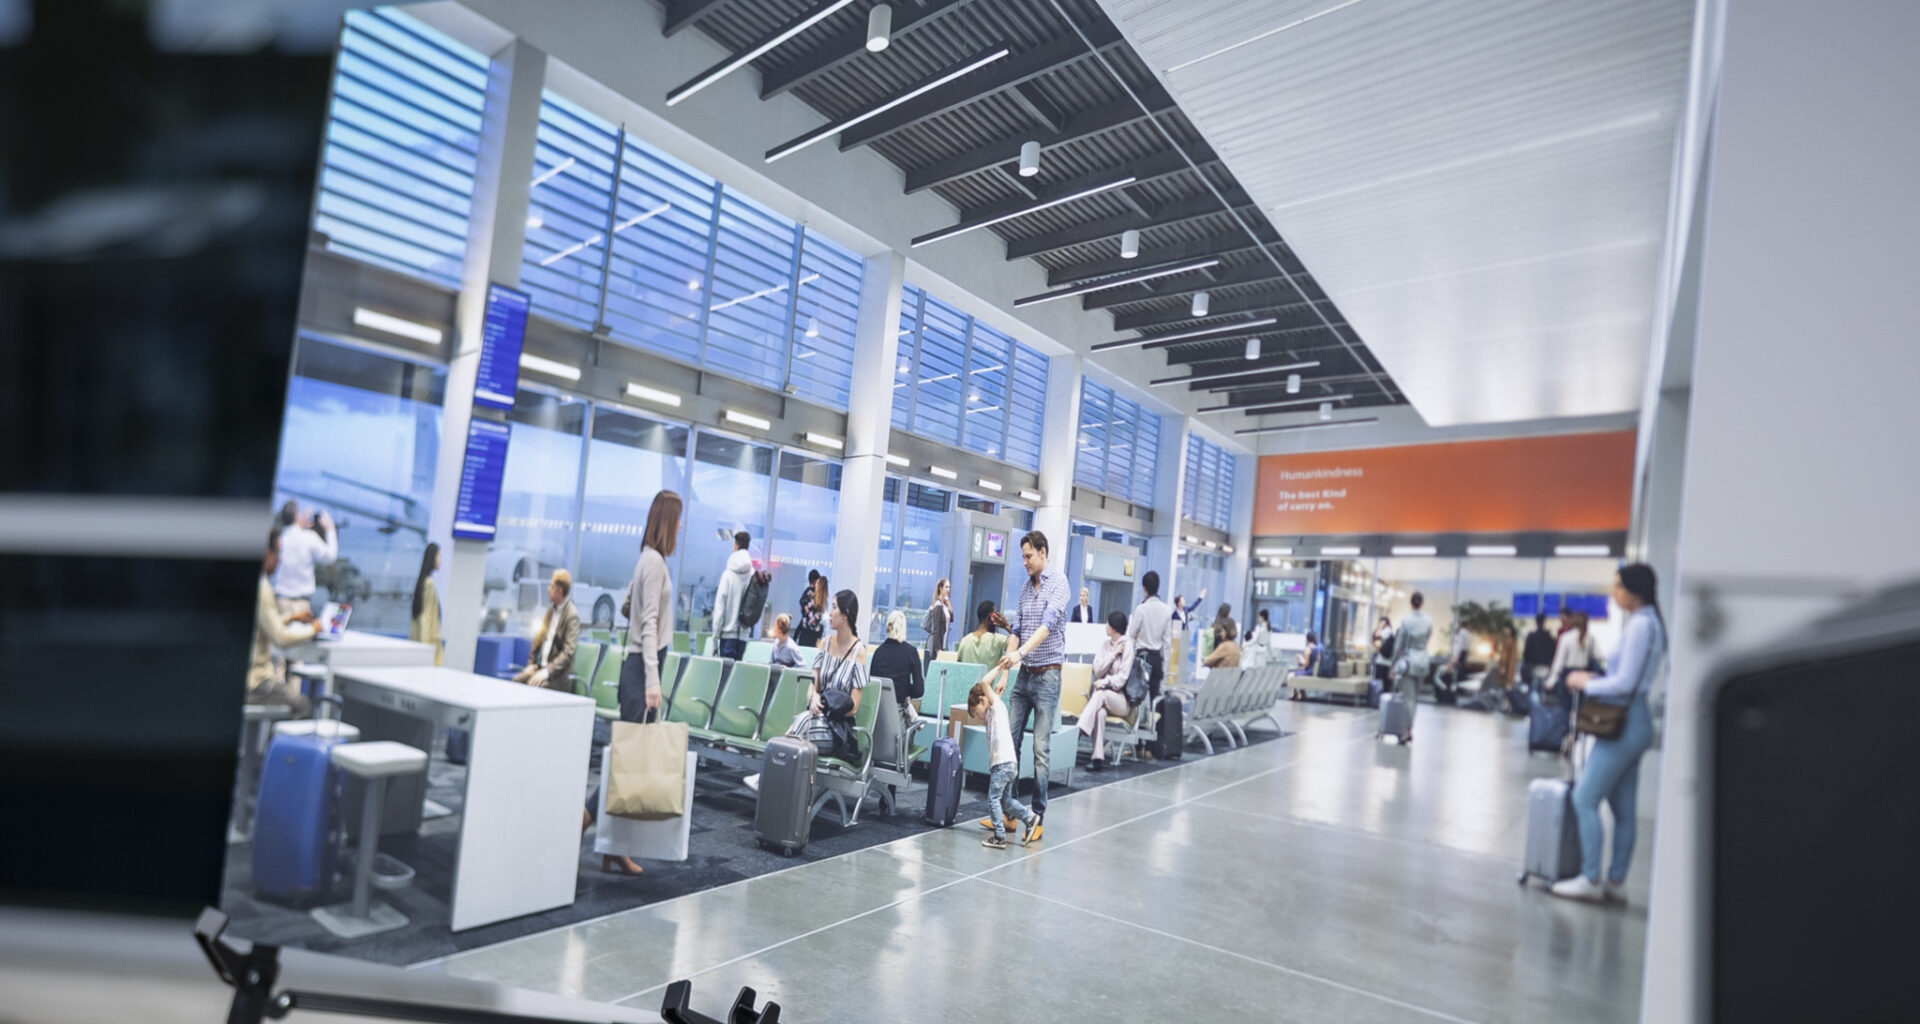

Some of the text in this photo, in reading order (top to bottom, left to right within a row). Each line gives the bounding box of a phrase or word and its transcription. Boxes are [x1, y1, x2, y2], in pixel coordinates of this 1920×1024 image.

[1280, 468, 1363, 480] Humankindness
[1279, 491, 1296, 499] The
[1298, 490, 1320, 499] best
[1277, 501, 1335, 512] of carry on.
[974, 532, 982, 552] 9
[1255, 580, 1269, 596] 11
